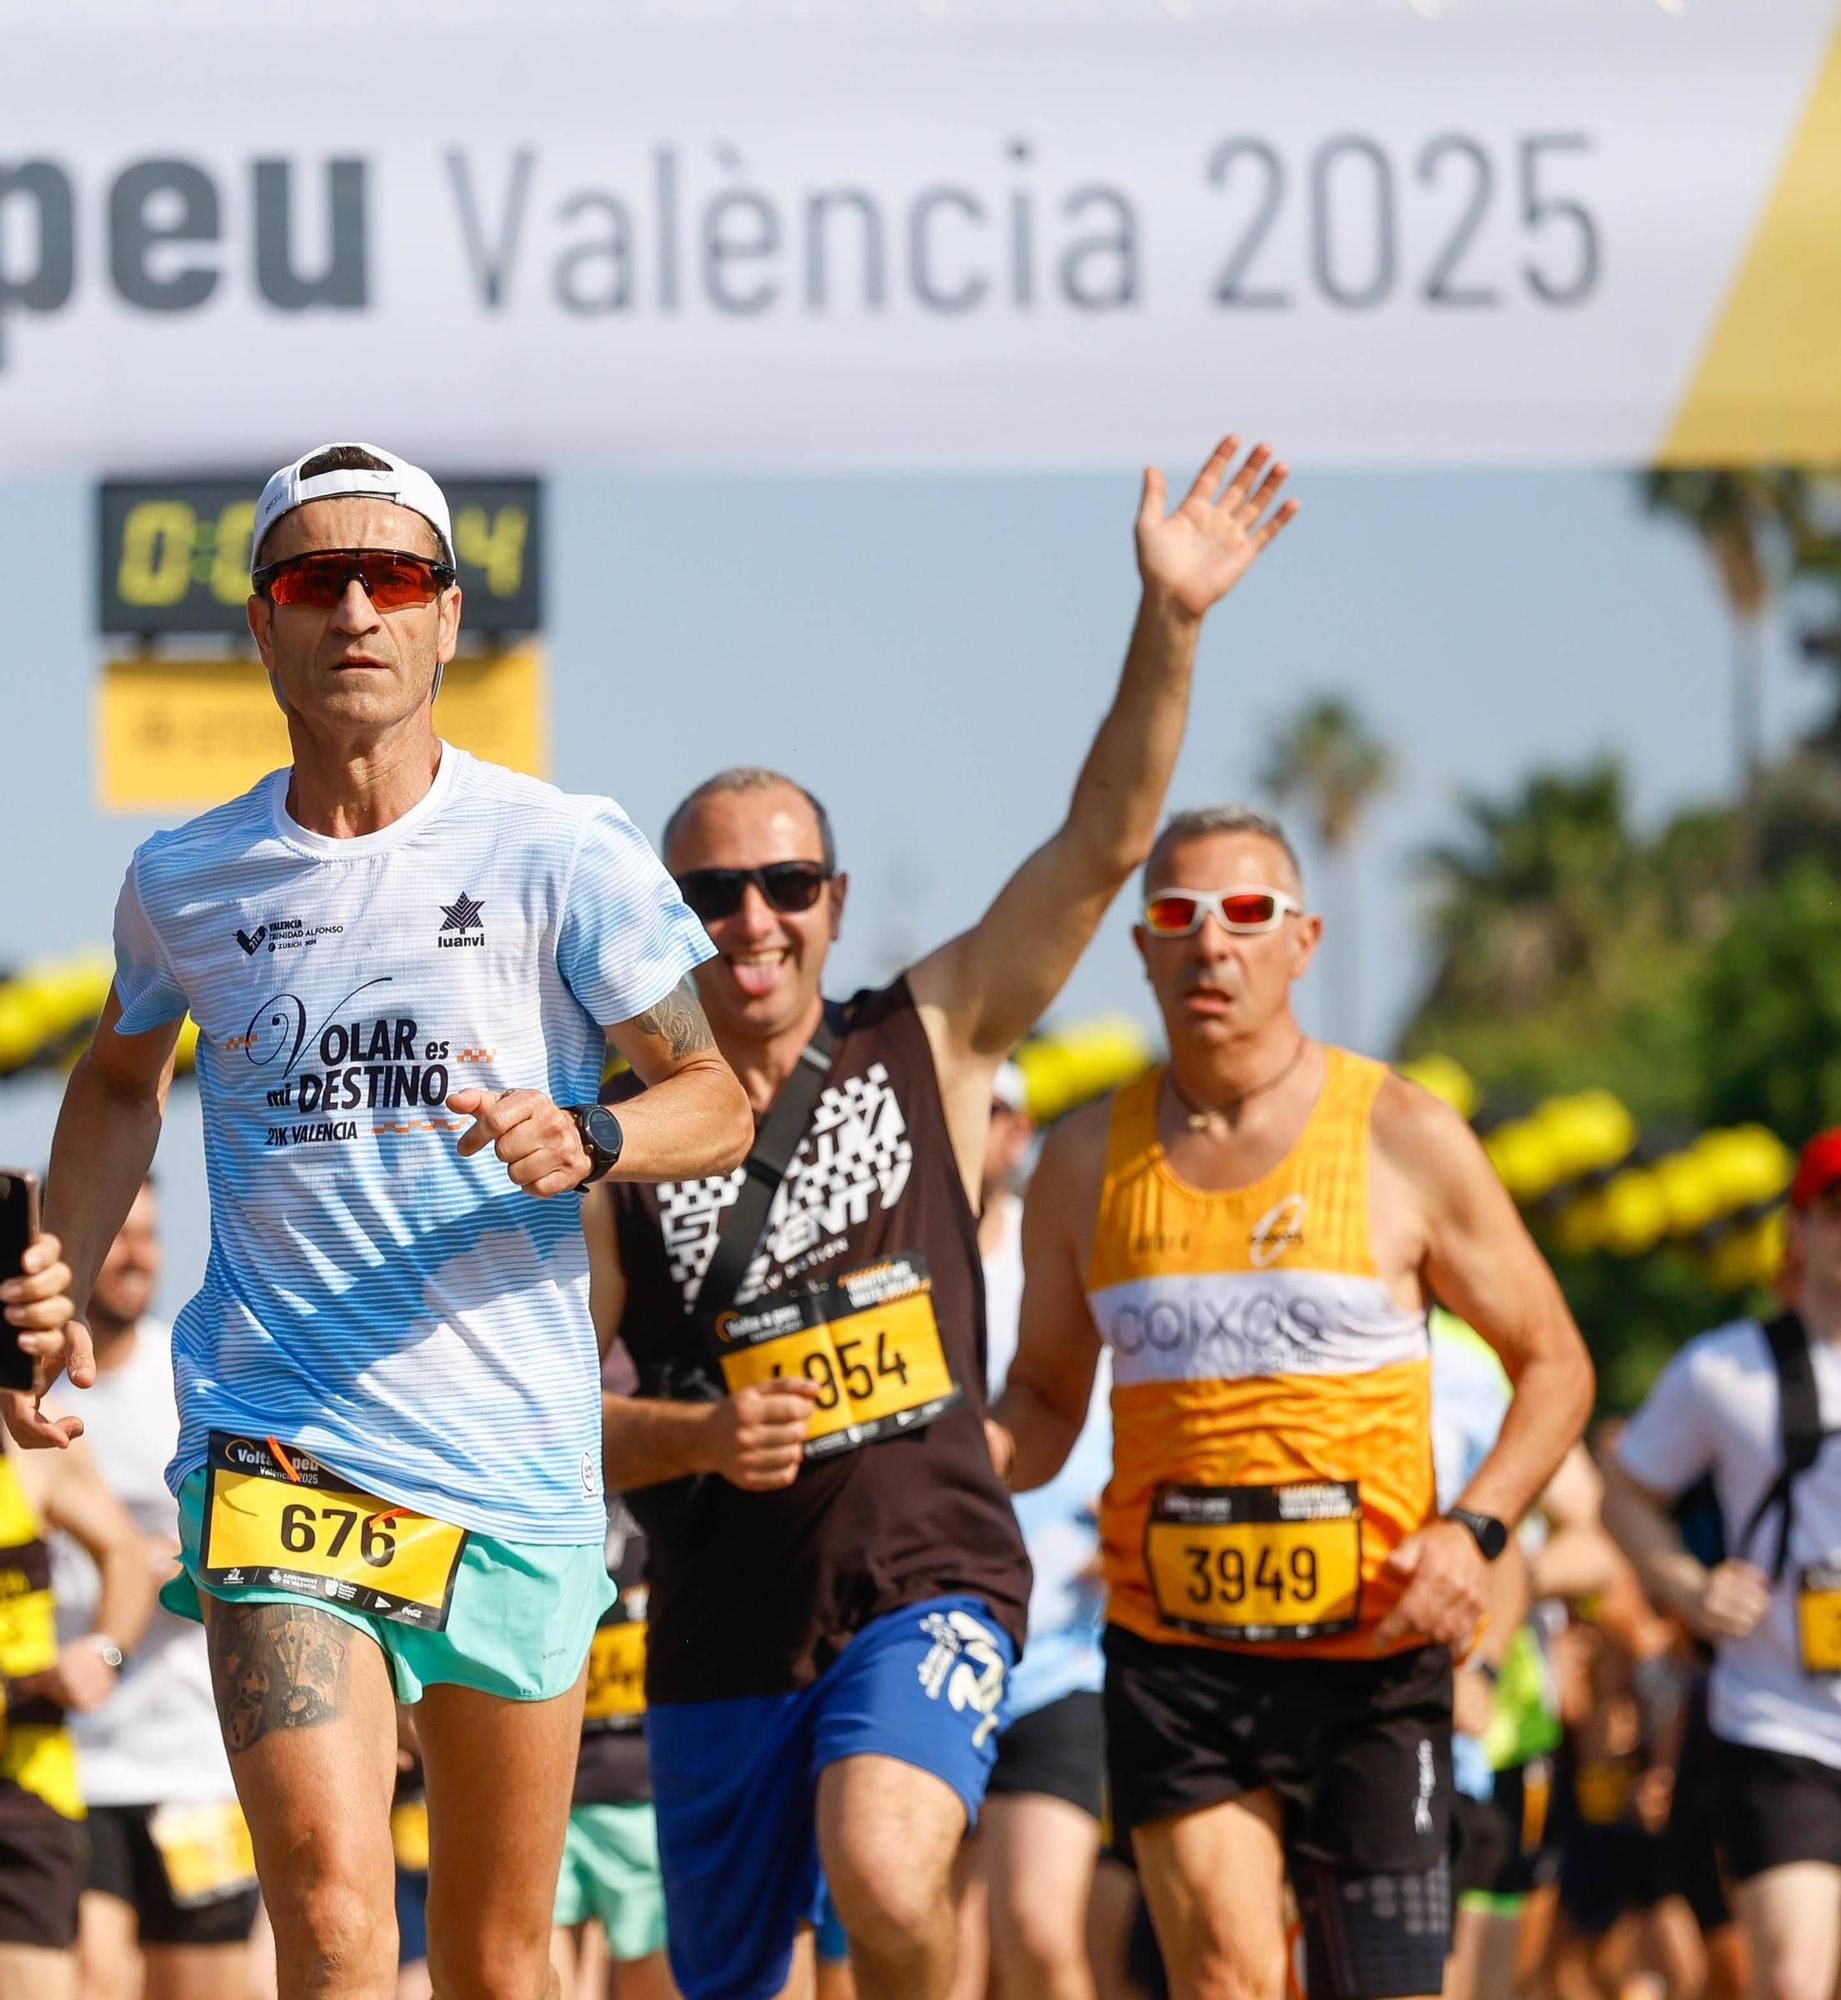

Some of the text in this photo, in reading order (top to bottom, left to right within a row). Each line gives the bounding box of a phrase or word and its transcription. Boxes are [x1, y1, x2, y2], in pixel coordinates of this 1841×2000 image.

[444, 144, 1141, 312] València
[1207, 134, 1603, 308] 2025
[269, 925, 344, 940] TRINIDAD ALFONSO
[438, 933, 485, 948] luanvi
[245, 976, 450, 1081] VOLAR es
[266, 1064, 449, 1113] mi DESTINO
[264, 1121, 358, 1147] 21K VALENCIA
[772, 1331, 908, 1410] 954
[280, 1503, 397, 1568] 676
[1184, 1546, 1318, 1606] 3949
